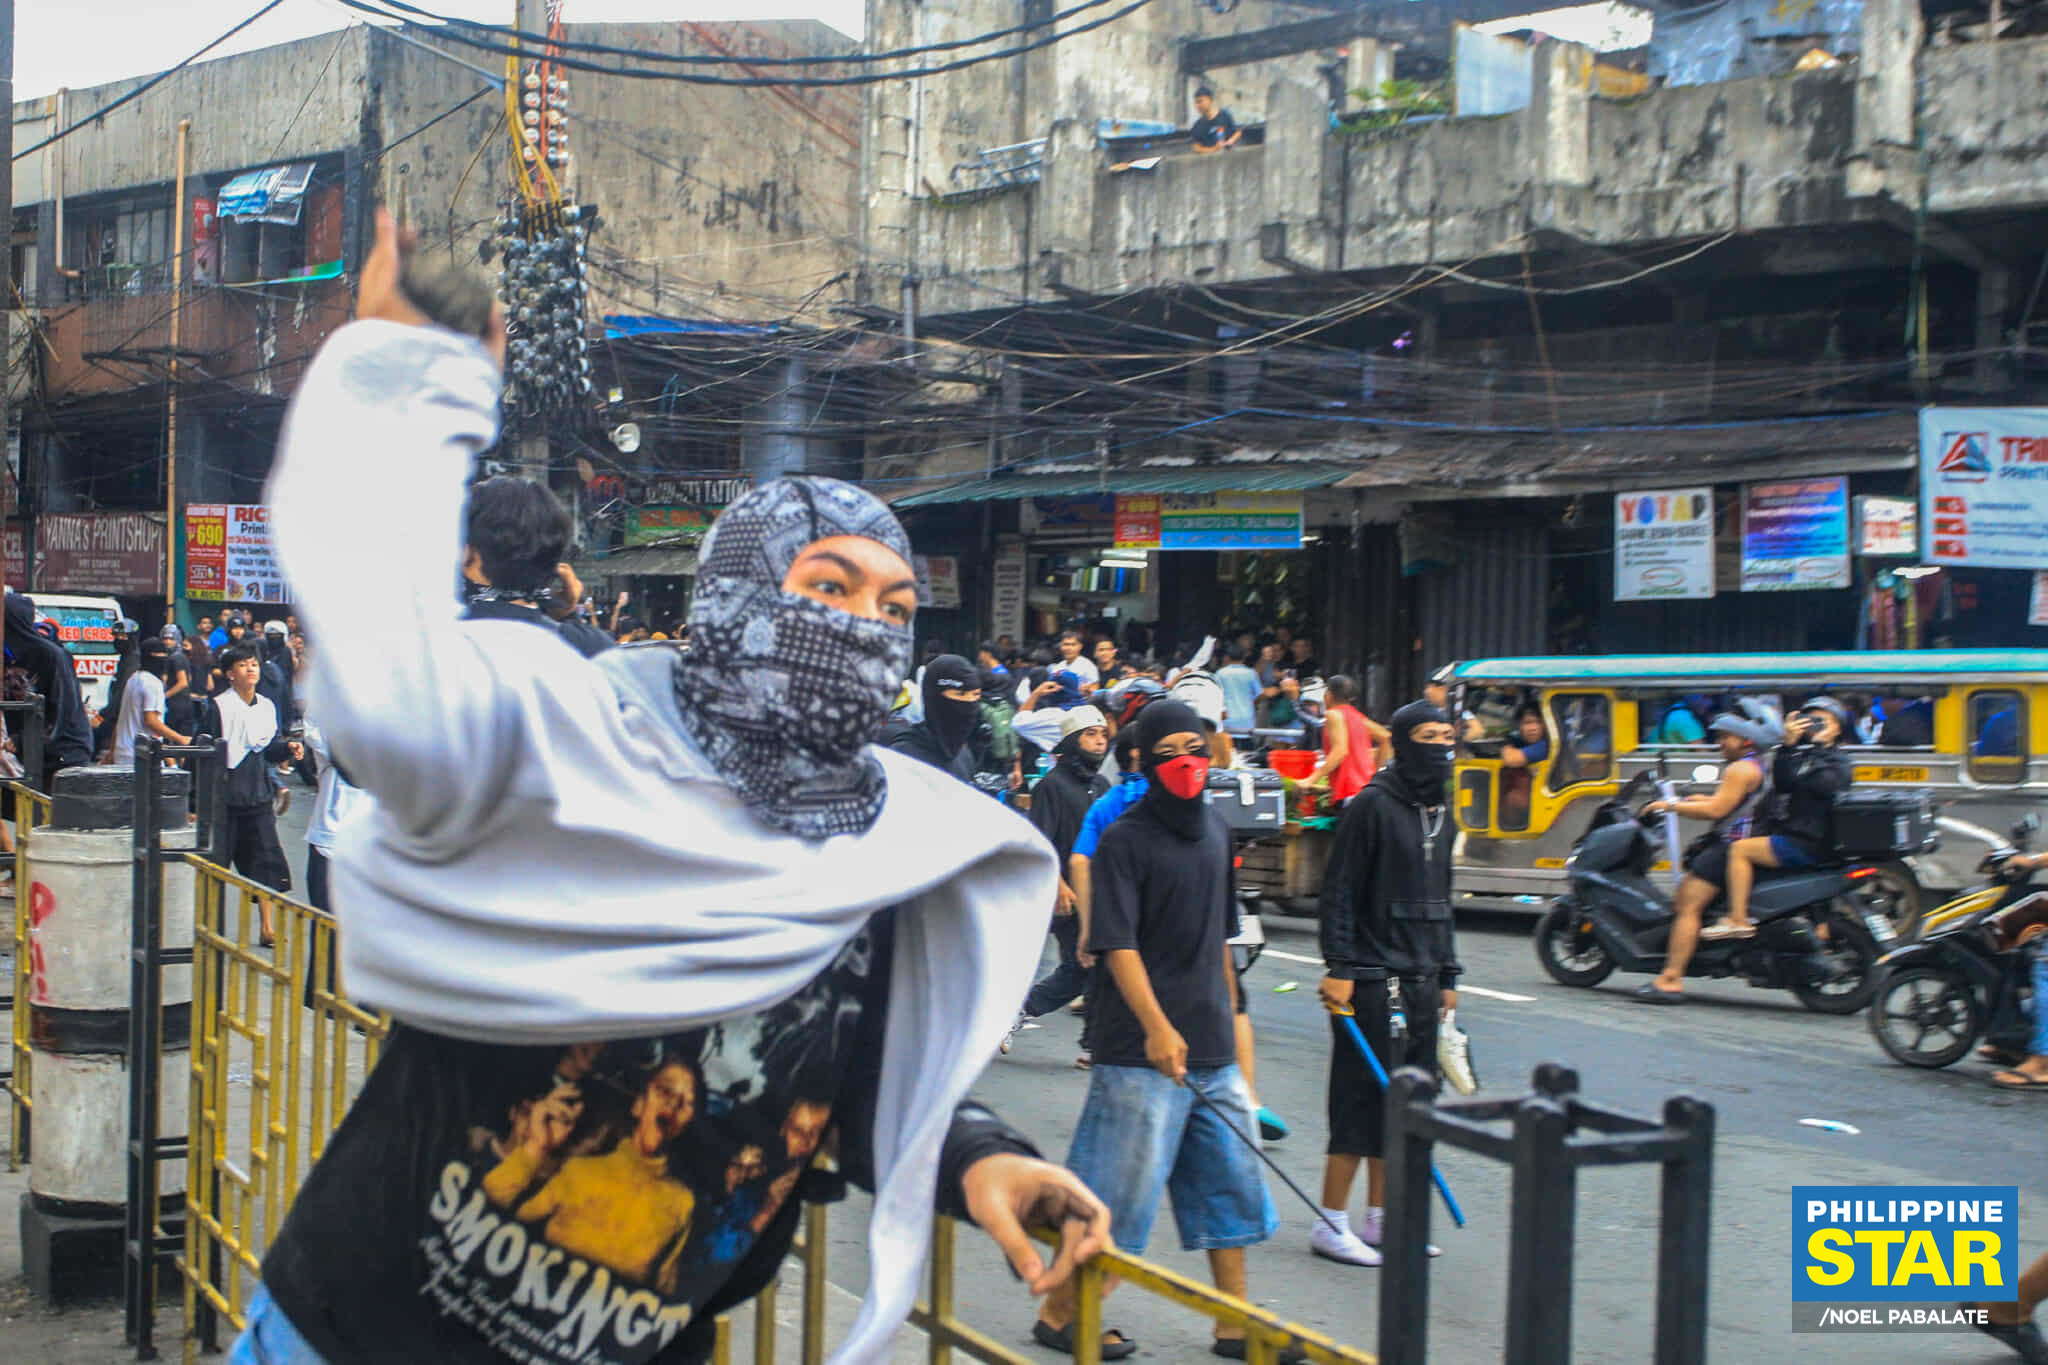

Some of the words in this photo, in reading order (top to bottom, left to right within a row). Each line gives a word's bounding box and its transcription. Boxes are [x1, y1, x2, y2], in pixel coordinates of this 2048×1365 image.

[234, 507, 271, 522] RIC
[92, 515, 160, 552] PRINTSHOP
[197, 525, 223, 546] 690
[57, 627, 81, 640] RED
[83, 627, 115, 641] CROS
